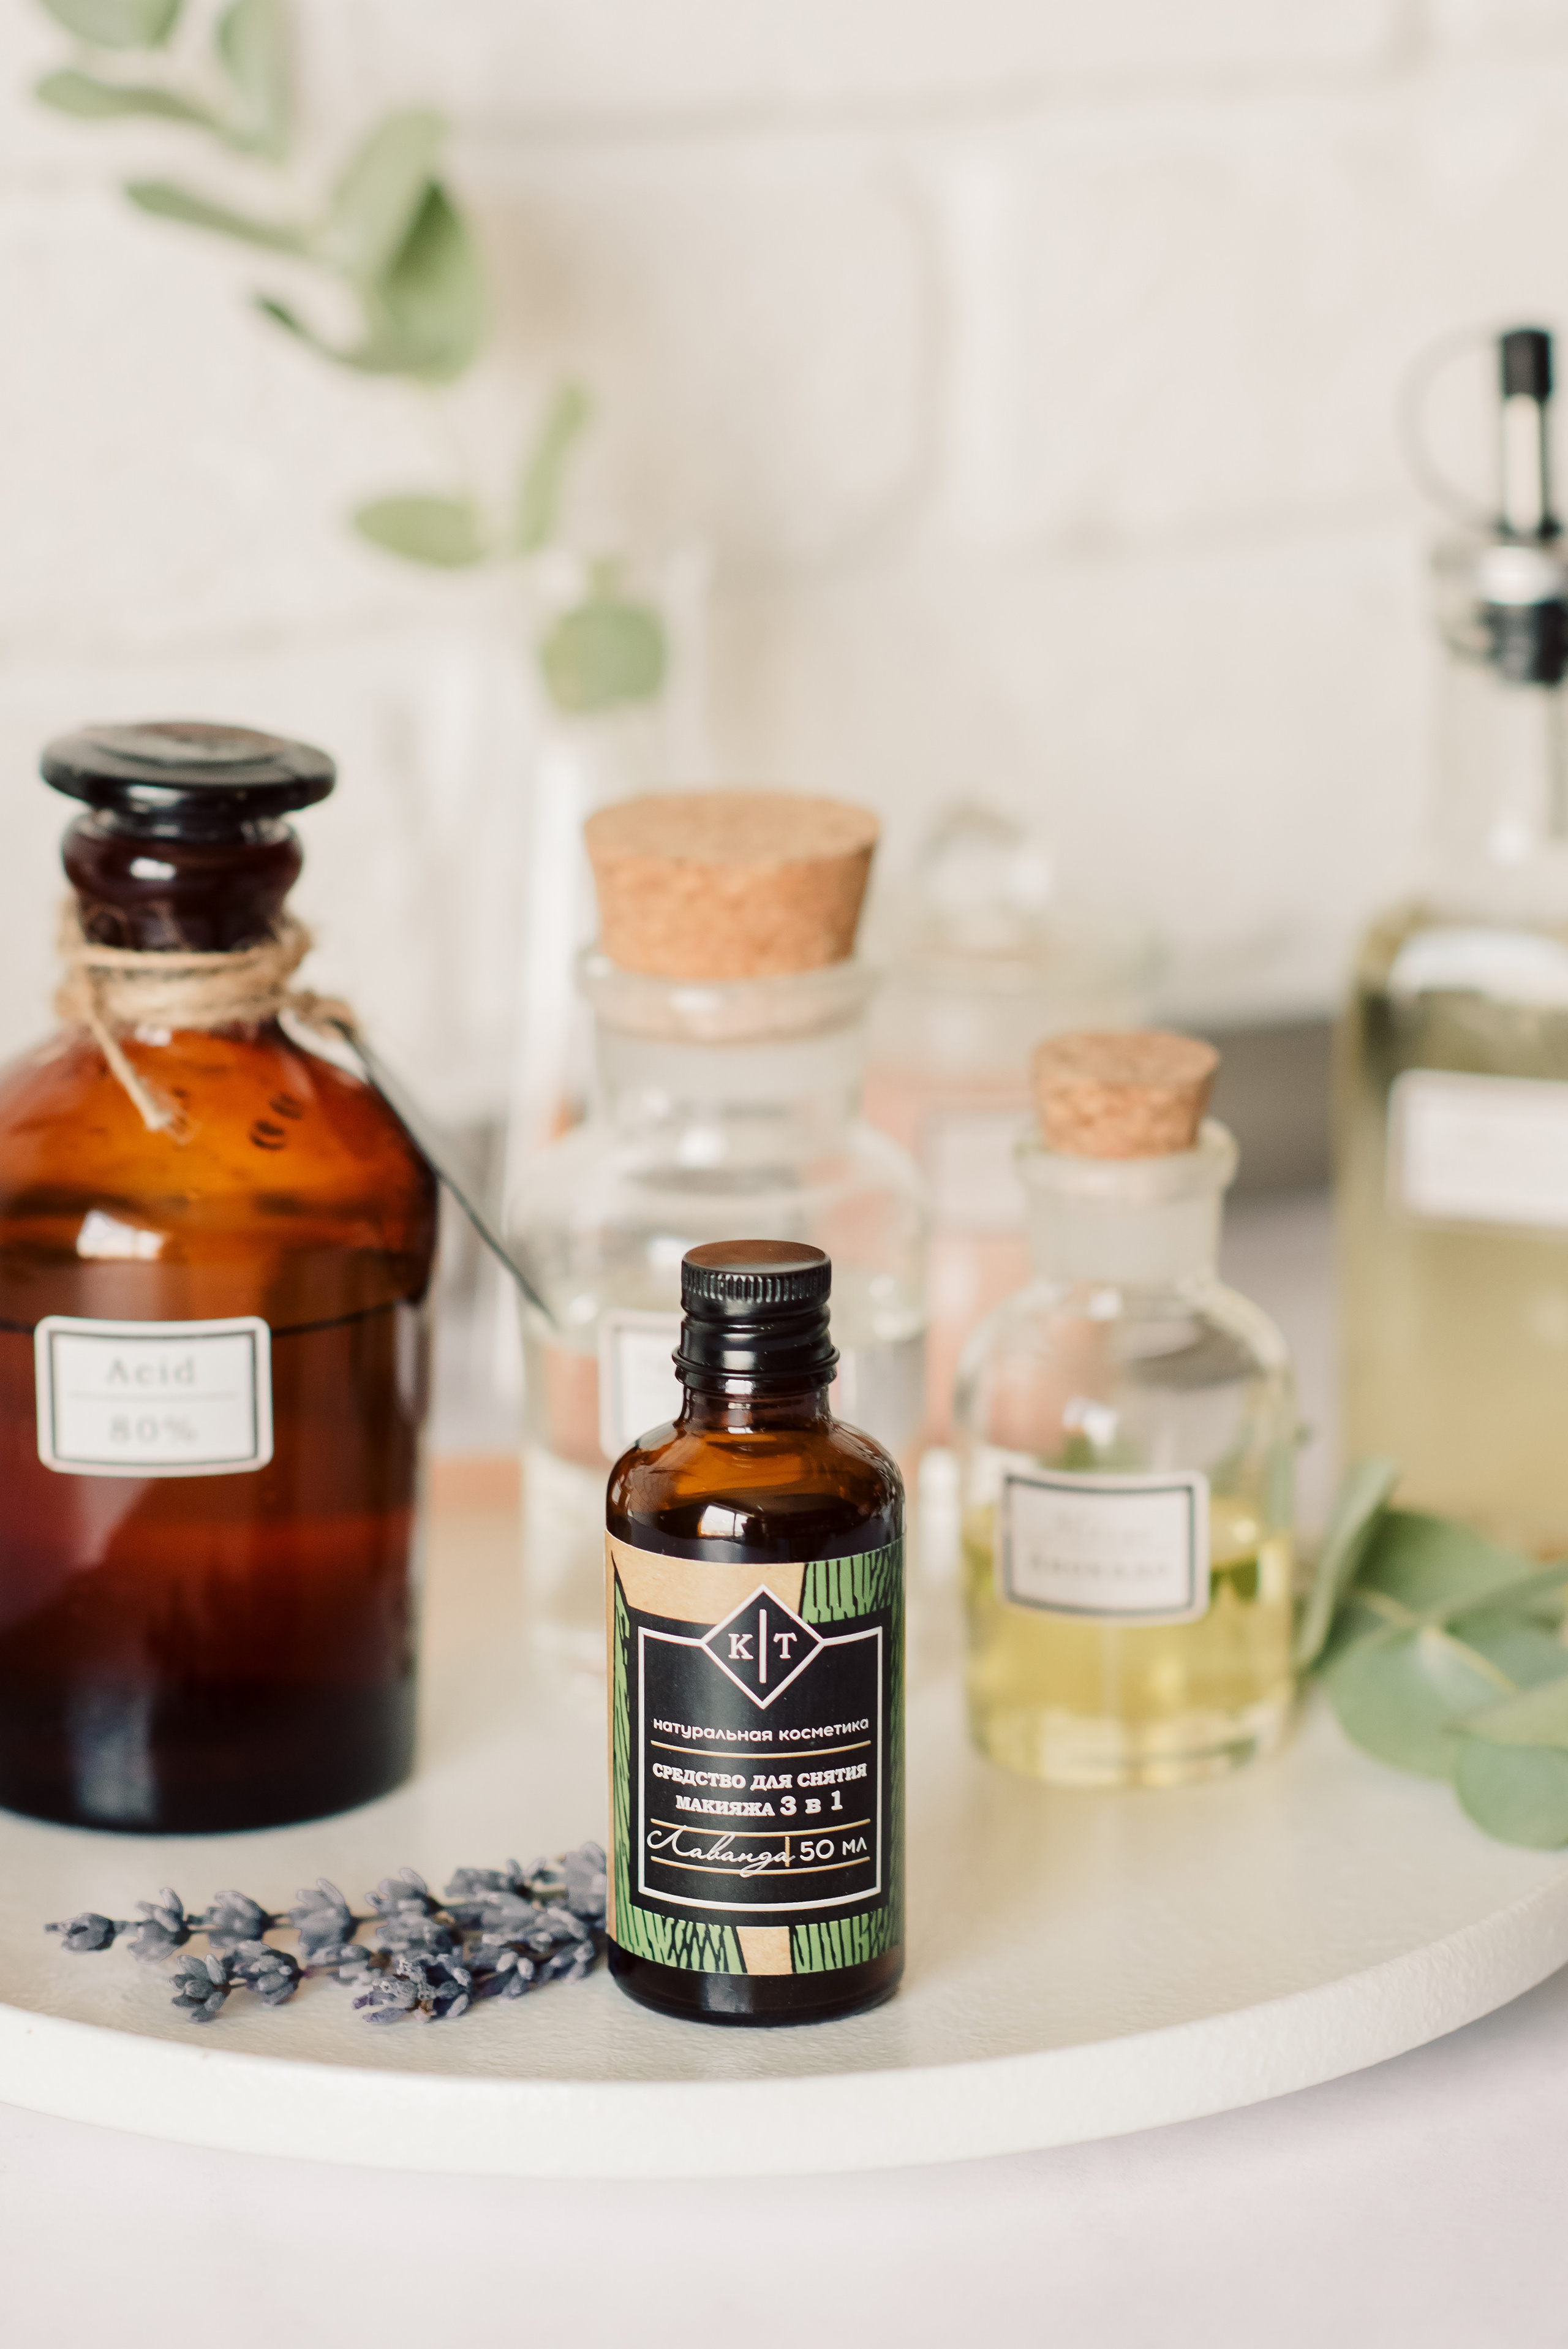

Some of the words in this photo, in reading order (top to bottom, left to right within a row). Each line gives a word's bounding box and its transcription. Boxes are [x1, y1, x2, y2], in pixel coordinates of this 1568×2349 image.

[105, 1357, 195, 1386] Acid
[109, 1415, 199, 1444] 80%
[653, 1718, 772, 1741] натуральная
[778, 1718, 869, 1741] косметика
[652, 1763, 746, 1789] СРЕДСТВО
[750, 1774, 793, 1791] ДЛЯ
[797, 1763, 867, 1787] СНЯТИЯ
[675, 1795, 775, 1817] МАКИЯЖА
[780, 1795, 796, 1816] 3
[831, 1790, 843, 1810] 1
[647, 1825, 796, 1878] Лаванда
[800, 1839, 834, 1861] 50
